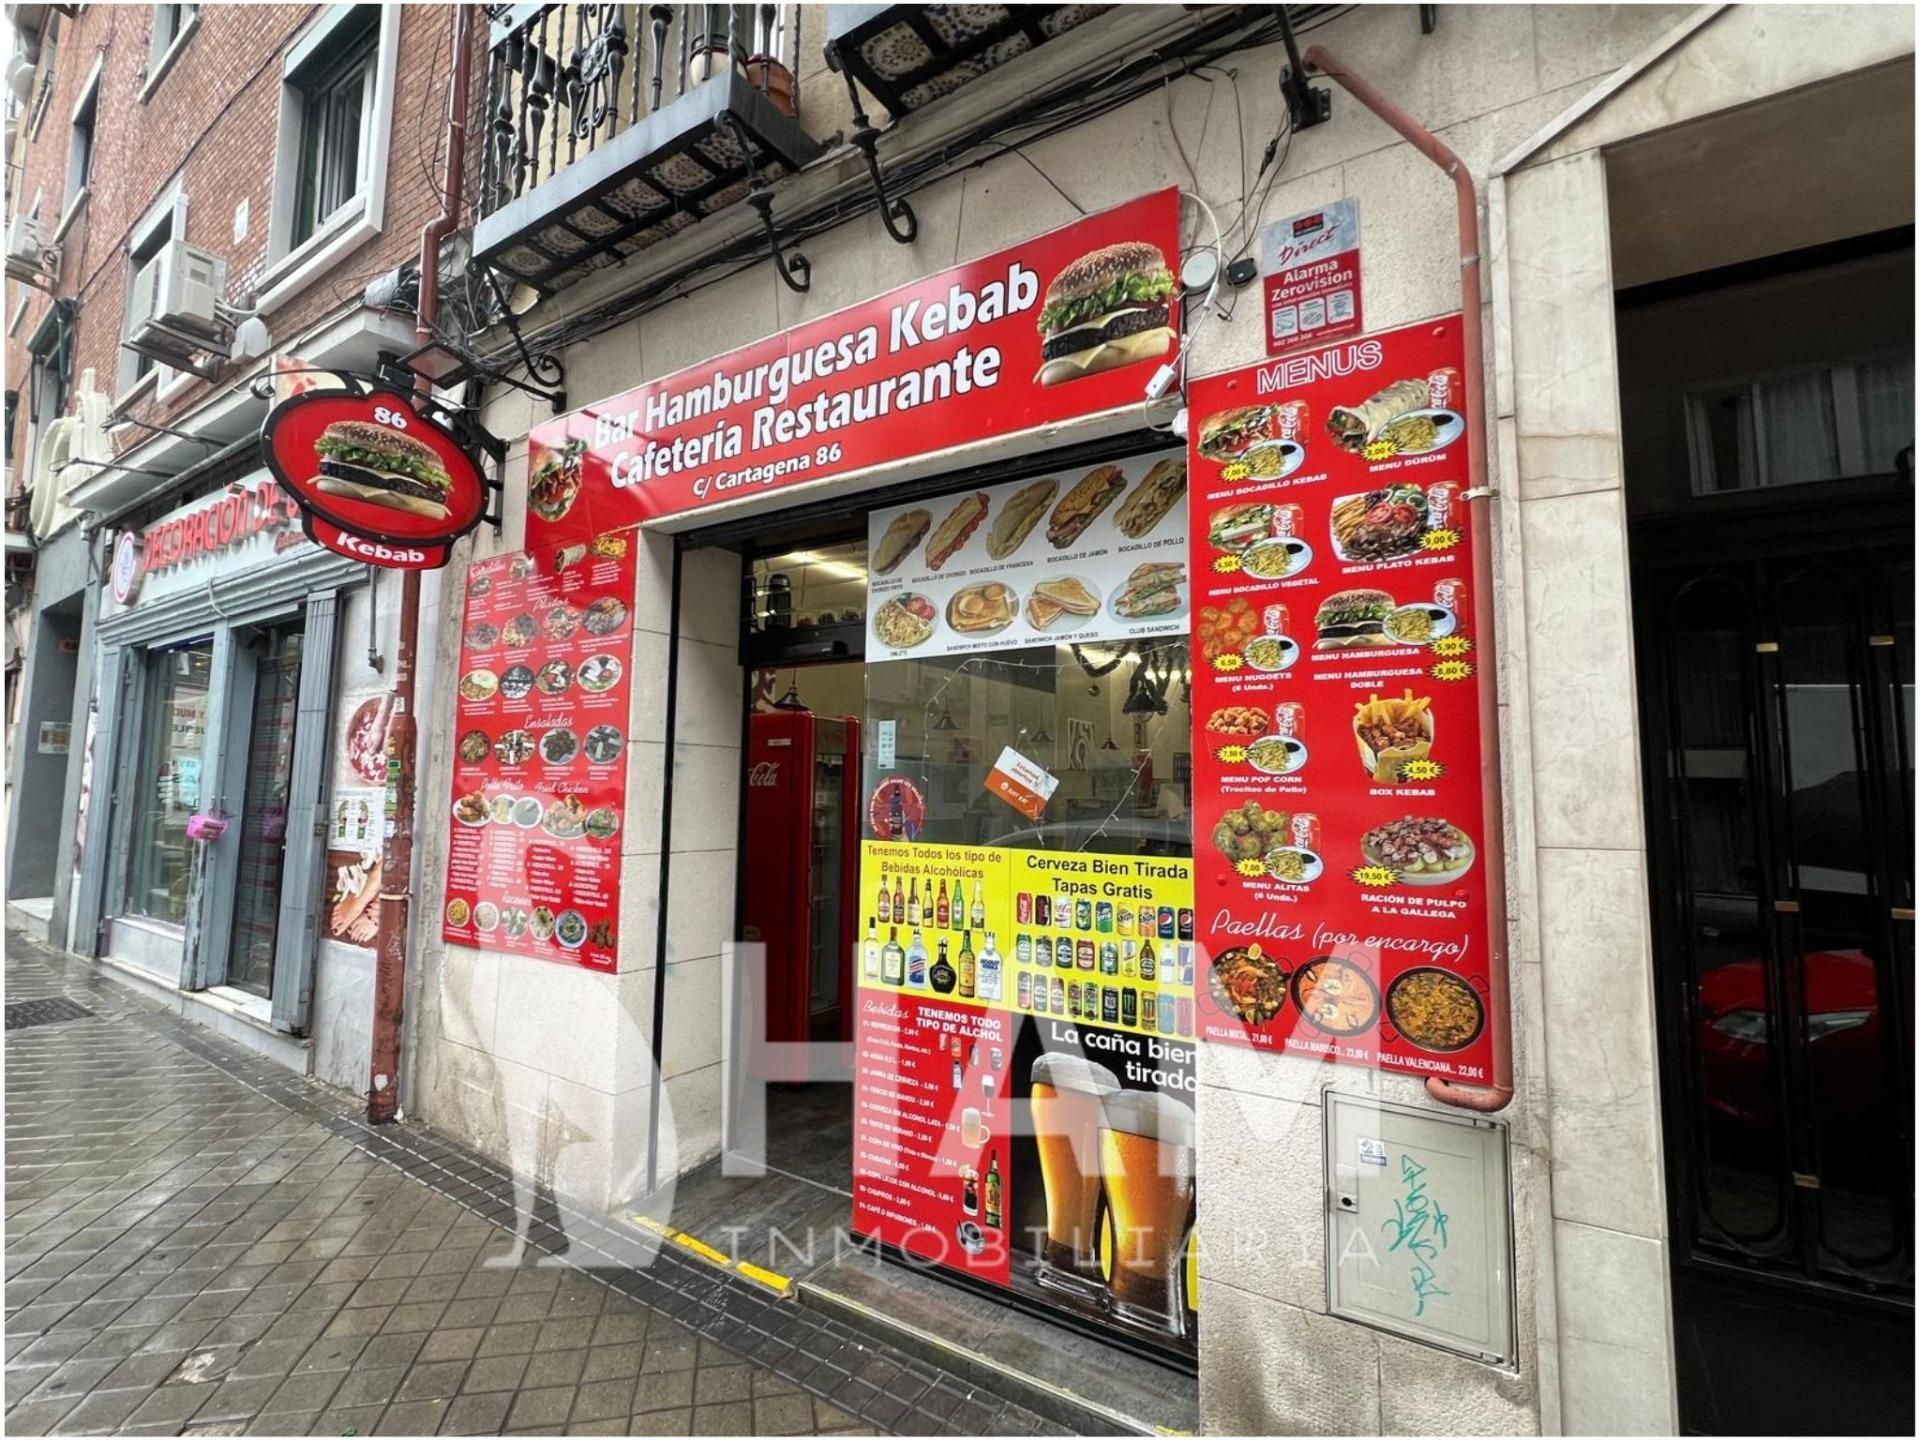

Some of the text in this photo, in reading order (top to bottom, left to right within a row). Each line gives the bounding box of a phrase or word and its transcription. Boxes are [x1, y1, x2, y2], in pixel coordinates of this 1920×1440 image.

[1282, 259, 1339, 285] Alarma
[1271, 269, 1353, 302] Zerovision
[594, 261, 1040, 449] Bar Hamburguesa Kebab
[1257, 341, 1383, 395] MENUS
[374, 407, 407, 429] 86
[609, 344, 1003, 489] Cafetería Restaurante
[692, 442, 843, 499] C/ Cartagena 86
[1369, 460, 1402, 472] MENU
[1207, 473, 1328, 500] MENU BOCADILLO KEBAB
[336, 531, 426, 563] Kebab
[1118, 541, 1153, 553] BOCADILLO
[1163, 537, 1185, 546] POLLO
[1425, 536, 1446, 546] 9,00
[1047, 553, 1078, 563] BOCADILLO
[1342, 555, 1455, 574] MENU PLATO KEBAB
[969, 565, 997, 575] BOCADILLO
[1208, 578, 1320, 596] MENU BOCADILLO VEGETAL
[1128, 624, 1180, 634] CLUB SANDWICH
[1024, 635, 1052, 644] SANDWICH
[1079, 631, 1099, 639] QUESO
[1311, 648, 1420, 662] MENU HAMBURGUESA
[1215, 672, 1292, 683] MENU NUGGETS
[1313, 667, 1424, 680] MENU HAMBURGUESA
[1350, 680, 1384, 688] DOBLE
[1220, 776, 1302, 784] MENU POP CORN
[1264, 786, 1277, 794] de
[1279, 786, 1307, 795] Pollo)
[1369, 788, 1436, 797] BOX KEBAB
[867, 845, 1002, 864] Tenemos Todos los tipo de
[881, 861, 921, 875] Bebidas
[1026, 855, 1189, 880] Cerveza Bien Tirada
[1052, 878, 1153, 900] Tapas Gratis
[1242, 881, 1310, 893] MENU ALITAS
[1266, 893, 1298, 904] Unds.)
[1360, 892, 1467, 909] RACIÓN DE PULPO
[1371, 906, 1456, 919] A LA GALLEGA
[1211, 909, 1304, 940] Paellas
[1312, 921, 1358, 950] (por
[1364, 933, 1469, 962] encargo)
[863, 1000, 909, 1020] Bebidas
[917, 1006, 1001, 1030] TENEMOS TODO
[916, 1017, 1003, 1042] TIPO DE ALCHOL
[1206, 1025, 1229, 1038] PAELLA
[1050, 1022, 1079, 1044] La
[1083, 1030, 1141, 1056] caña
[1284, 1037, 1309, 1050] PAELLA
[1376, 1052, 1404, 1065] PAELLA
